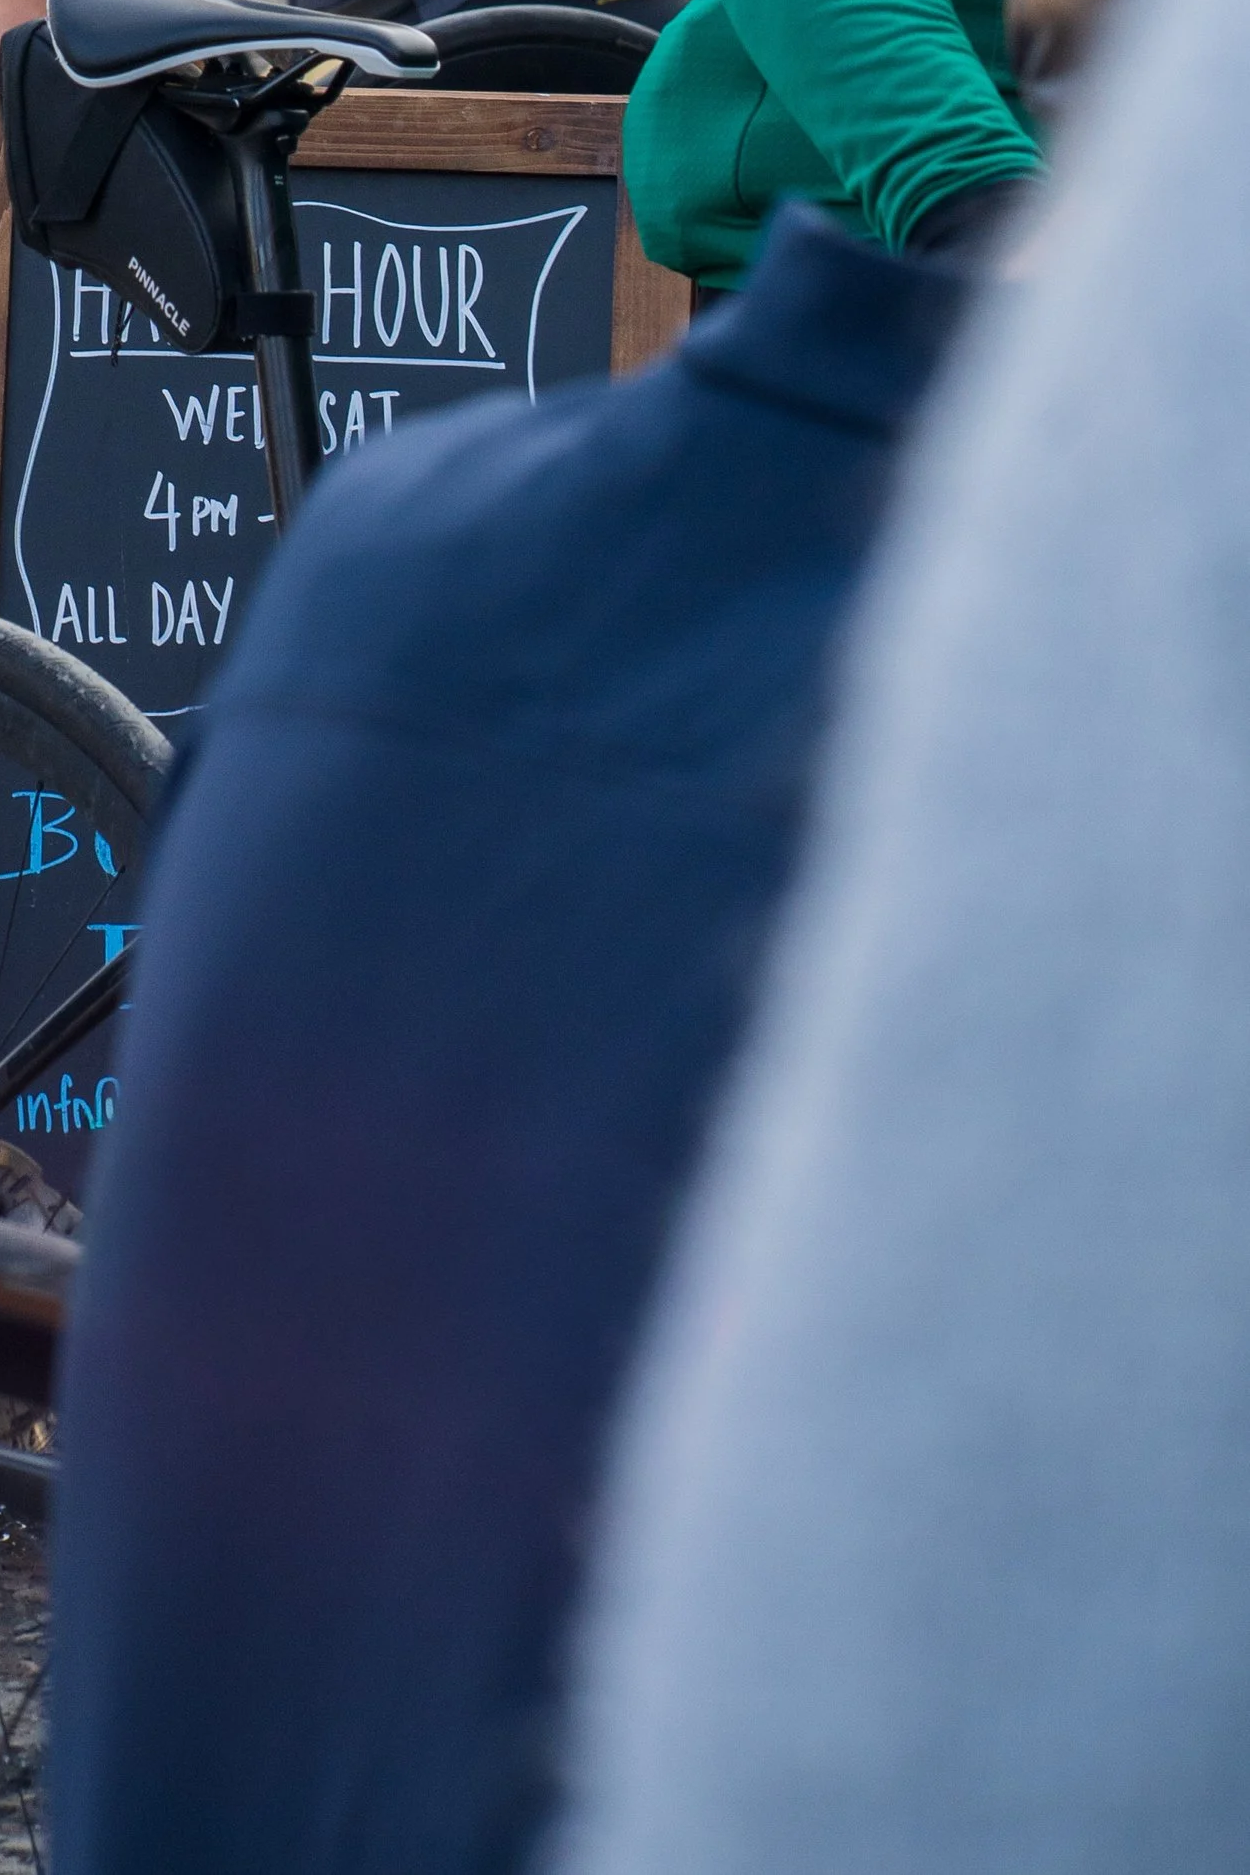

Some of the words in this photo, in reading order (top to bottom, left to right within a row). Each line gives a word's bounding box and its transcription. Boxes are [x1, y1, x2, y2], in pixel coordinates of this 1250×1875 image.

[128, 256, 191, 337] PINNACLE
[321, 240, 497, 359] HOUR
[318, 389, 400, 456] SAT
[52, 582, 127, 644] ALL
[151, 576, 234, 647] DAY
